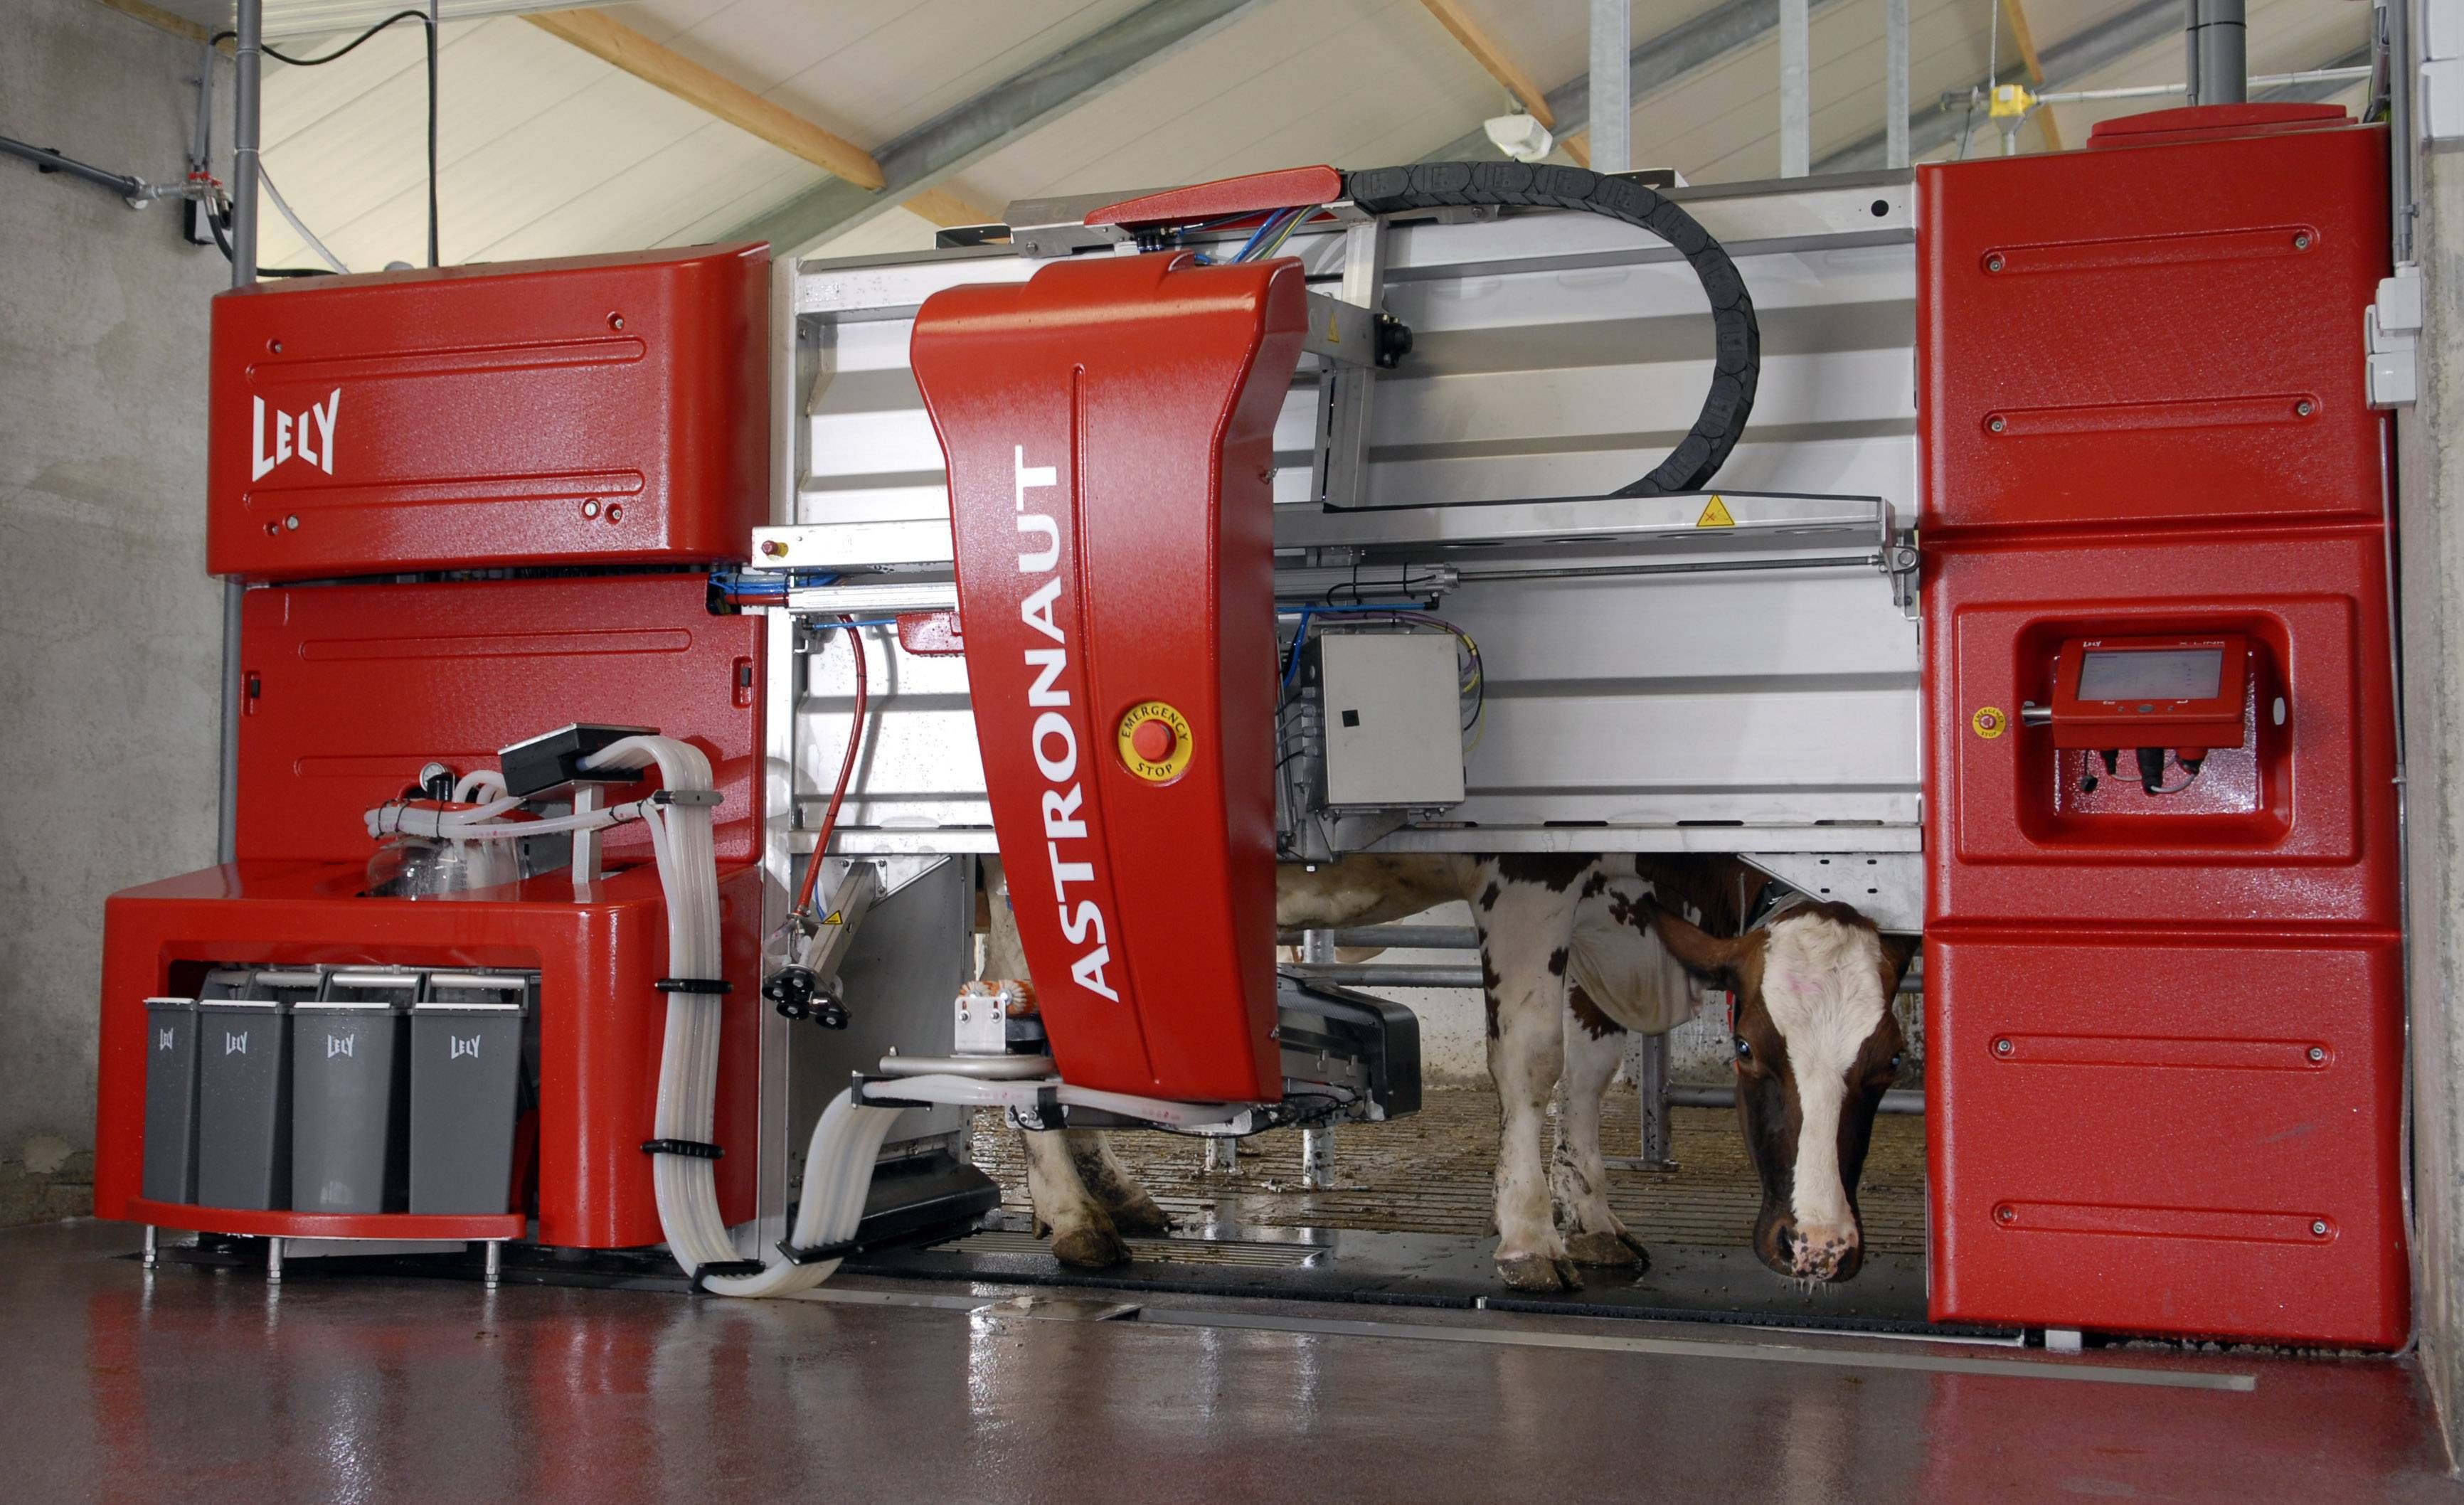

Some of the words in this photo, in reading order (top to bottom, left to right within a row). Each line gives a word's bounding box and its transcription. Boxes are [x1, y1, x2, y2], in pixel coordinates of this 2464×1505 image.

[252, 388, 341, 482] LELY
[1014, 445, 1119, 1003] ASTRONAUT
[1122, 706, 1189, 741] EMERGENCY
[1137, 762, 1172, 777] STOP
[159, 1028, 174, 1051] LELY
[225, 1031, 248, 1055] LELY
[327, 1033, 354, 1058] LELY
[451, 1034, 481, 1060] LELY
